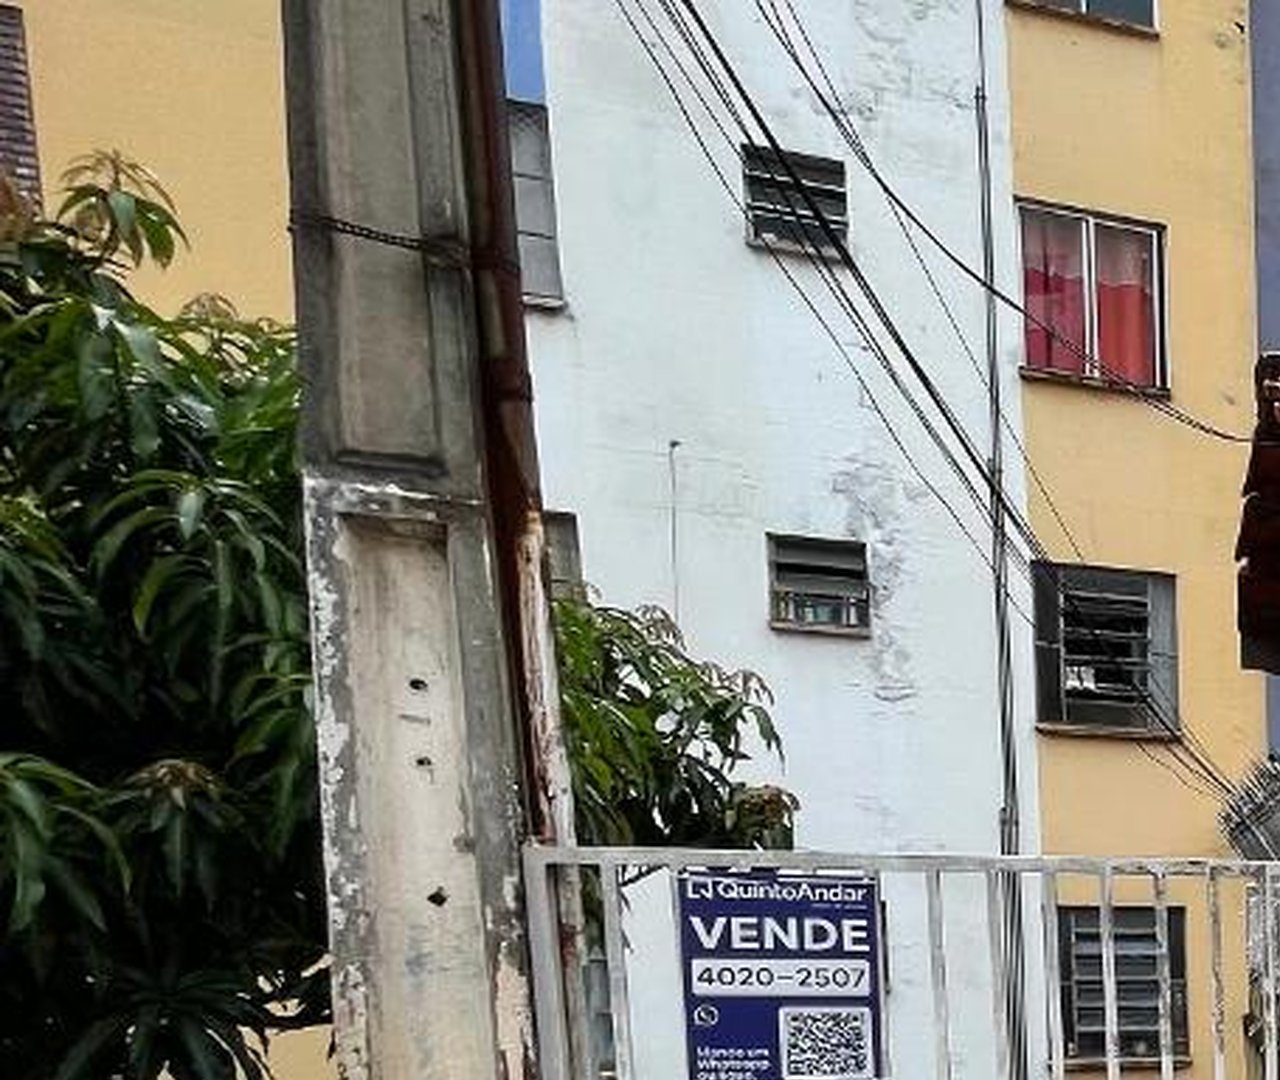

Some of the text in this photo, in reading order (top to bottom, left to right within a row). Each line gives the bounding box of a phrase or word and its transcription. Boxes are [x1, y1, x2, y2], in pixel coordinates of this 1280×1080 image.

[718, 881, 868, 901] QuintoAndar
[688, 916, 871, 951] VENDE
[697, 967, 866, 988] 4020-2507
